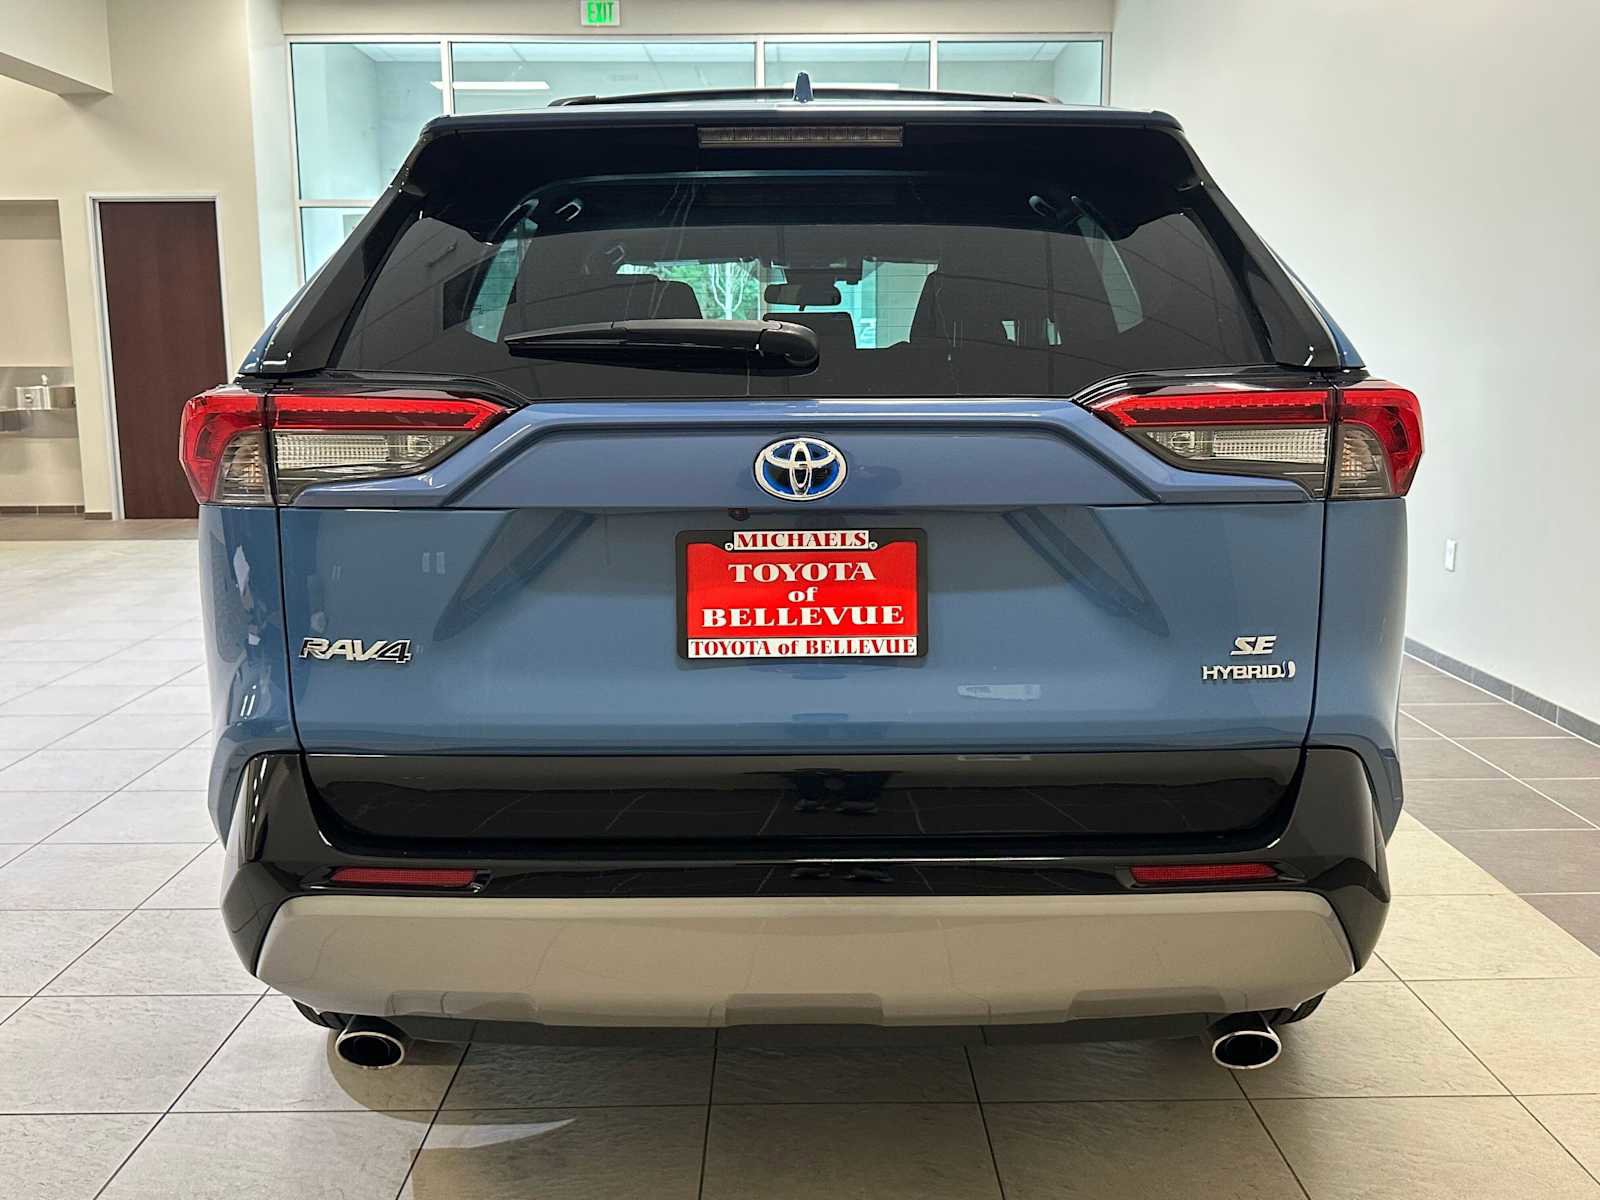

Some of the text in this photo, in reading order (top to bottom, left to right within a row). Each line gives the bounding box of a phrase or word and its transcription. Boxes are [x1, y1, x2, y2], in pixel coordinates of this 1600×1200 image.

[587, 1, 613, 22] EXIT
[737, 531, 867, 549] MICHAELS
[728, 562, 876, 583] TOYOTA
[787, 586, 818, 602] of
[701, 605, 904, 627] BELLEVUE
[298, 637, 412, 663] RAV4
[690, 638, 915, 656] TOYOTA of BELLEVUE
[1230, 635, 1277, 655] SE
[1202, 664, 1282, 679] HYBRID
